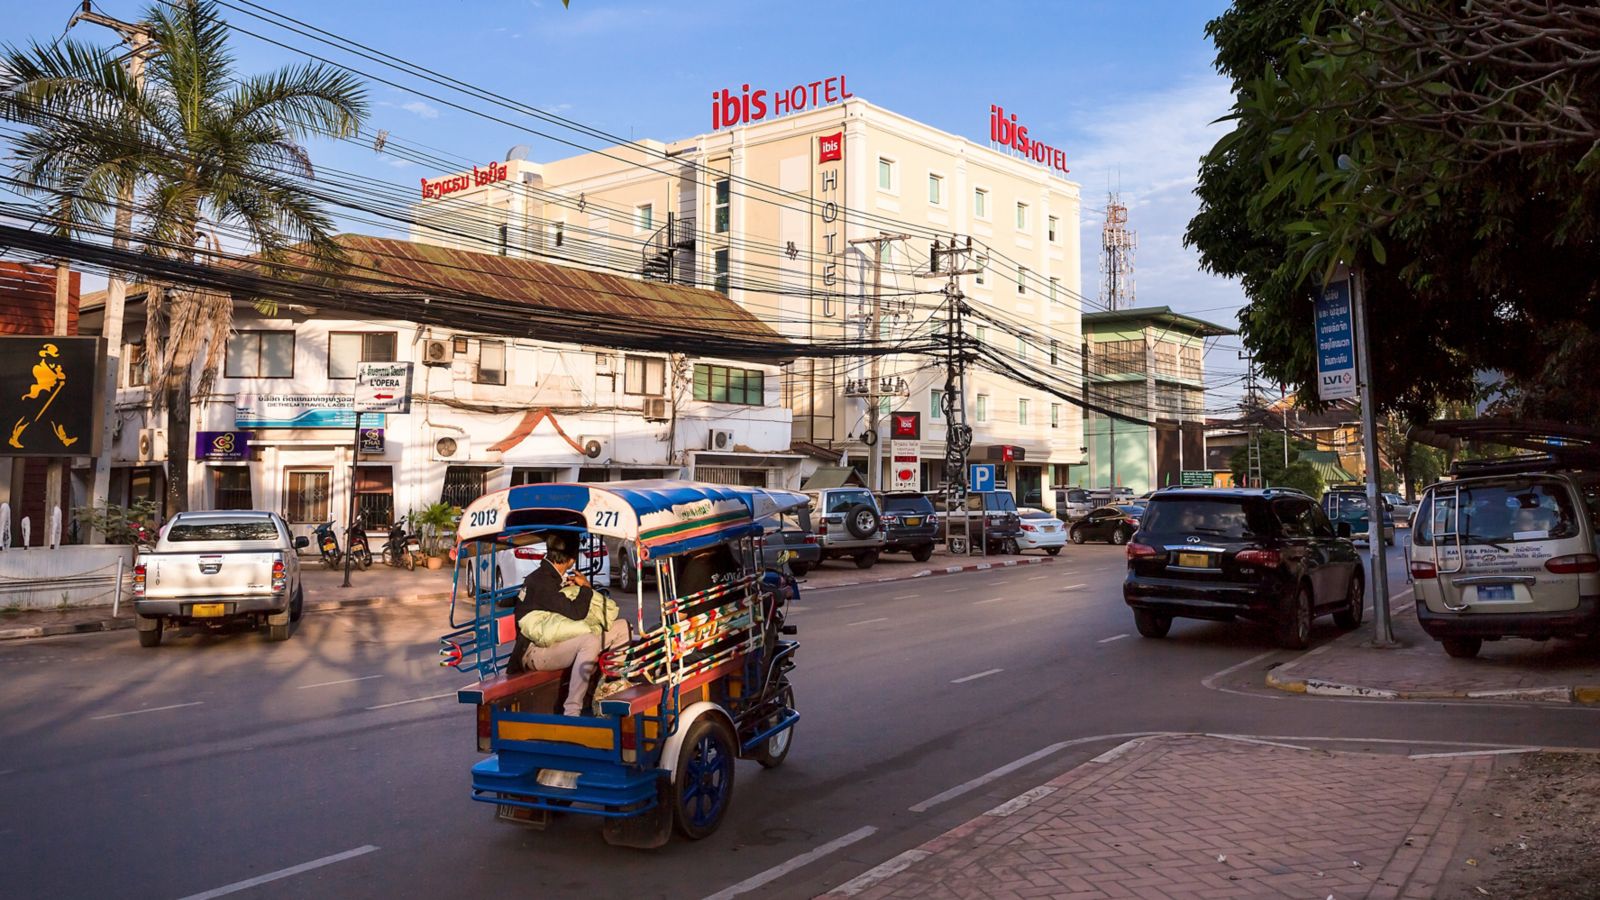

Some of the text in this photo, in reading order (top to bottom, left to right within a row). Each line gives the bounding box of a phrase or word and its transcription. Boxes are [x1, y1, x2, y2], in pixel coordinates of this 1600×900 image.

[713, 75, 853, 130] ibis HOTEL
[822, 140, 838, 153] ibis
[991, 104, 1070, 173] ibis HOTEL
[822, 168, 838, 318] HOTEL
[370, 379, 400, 387] L'OPERA
[1323, 375, 1342, 385] LVI
[976, 467, 989, 490] P
[470, 509, 498, 527] 2013
[595, 511, 619, 527] 271
